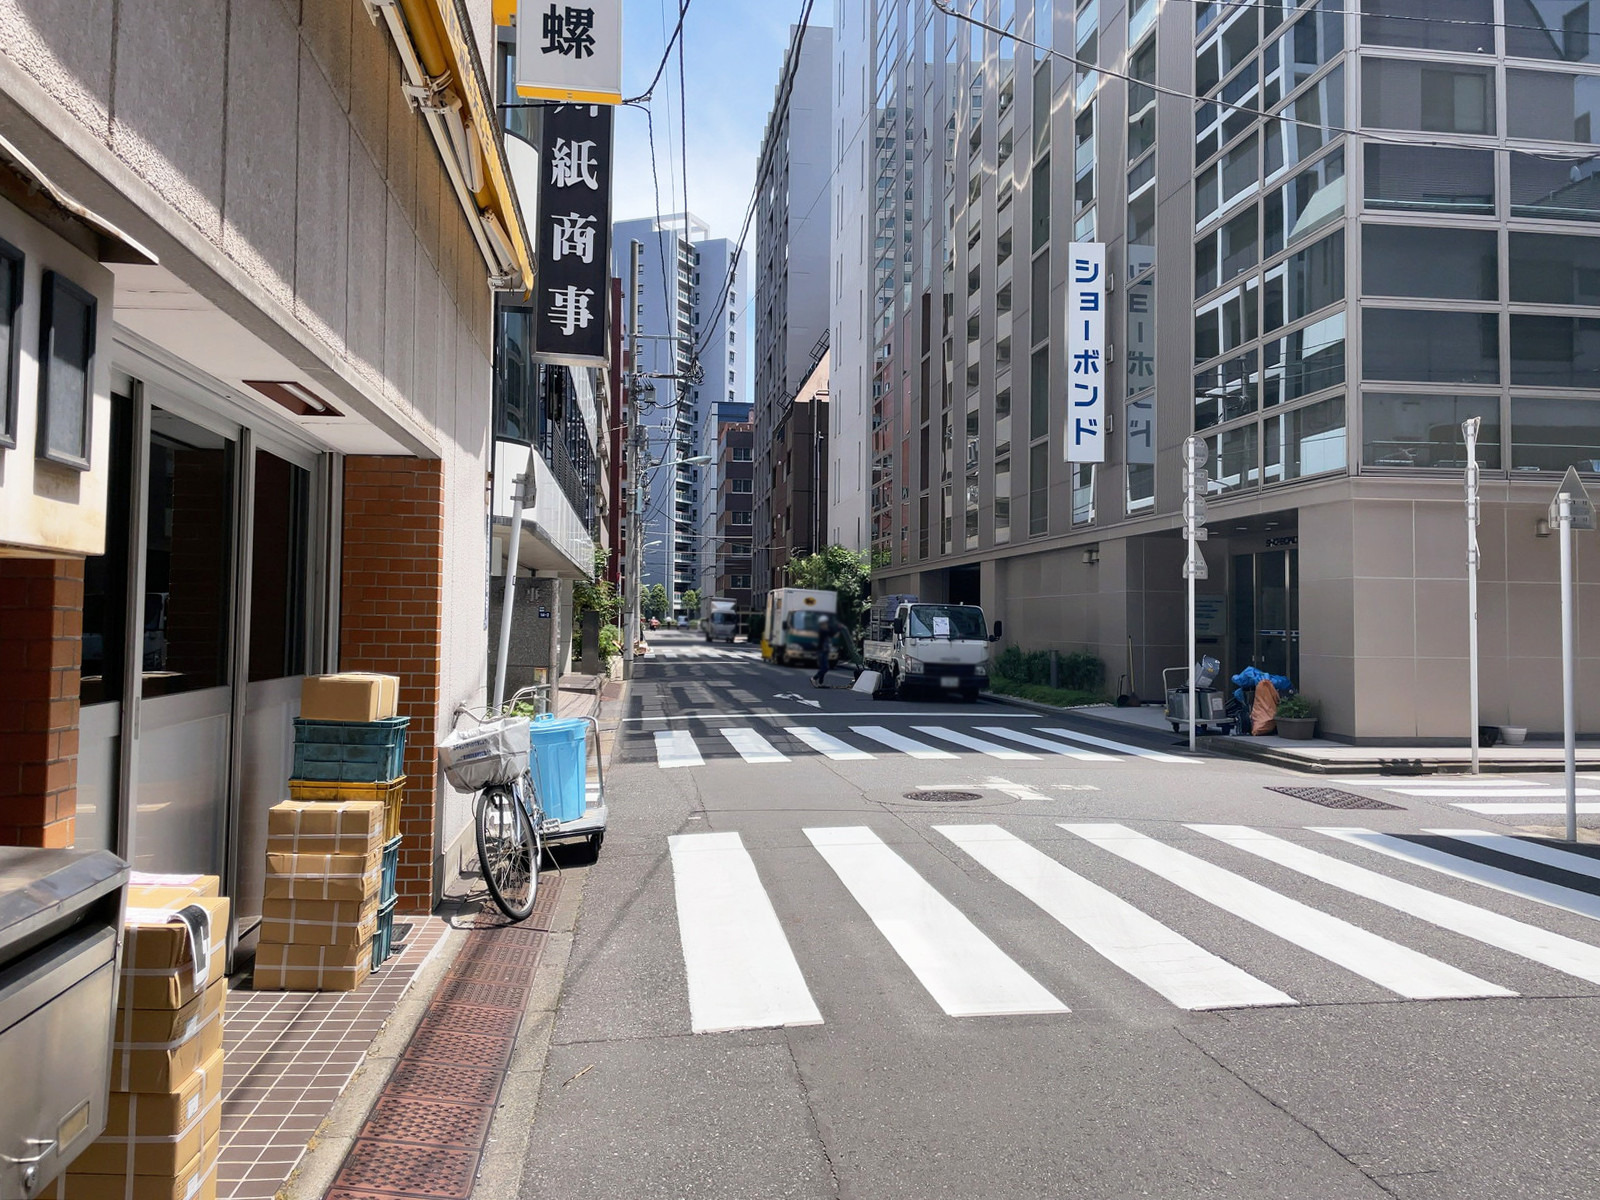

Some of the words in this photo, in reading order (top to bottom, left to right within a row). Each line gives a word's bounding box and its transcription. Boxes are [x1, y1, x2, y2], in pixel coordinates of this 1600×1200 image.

[541, 4, 595, 59] 螺
[547, 103, 599, 336] 紙商事
[1073, 259, 1100, 446] ショーボンド
